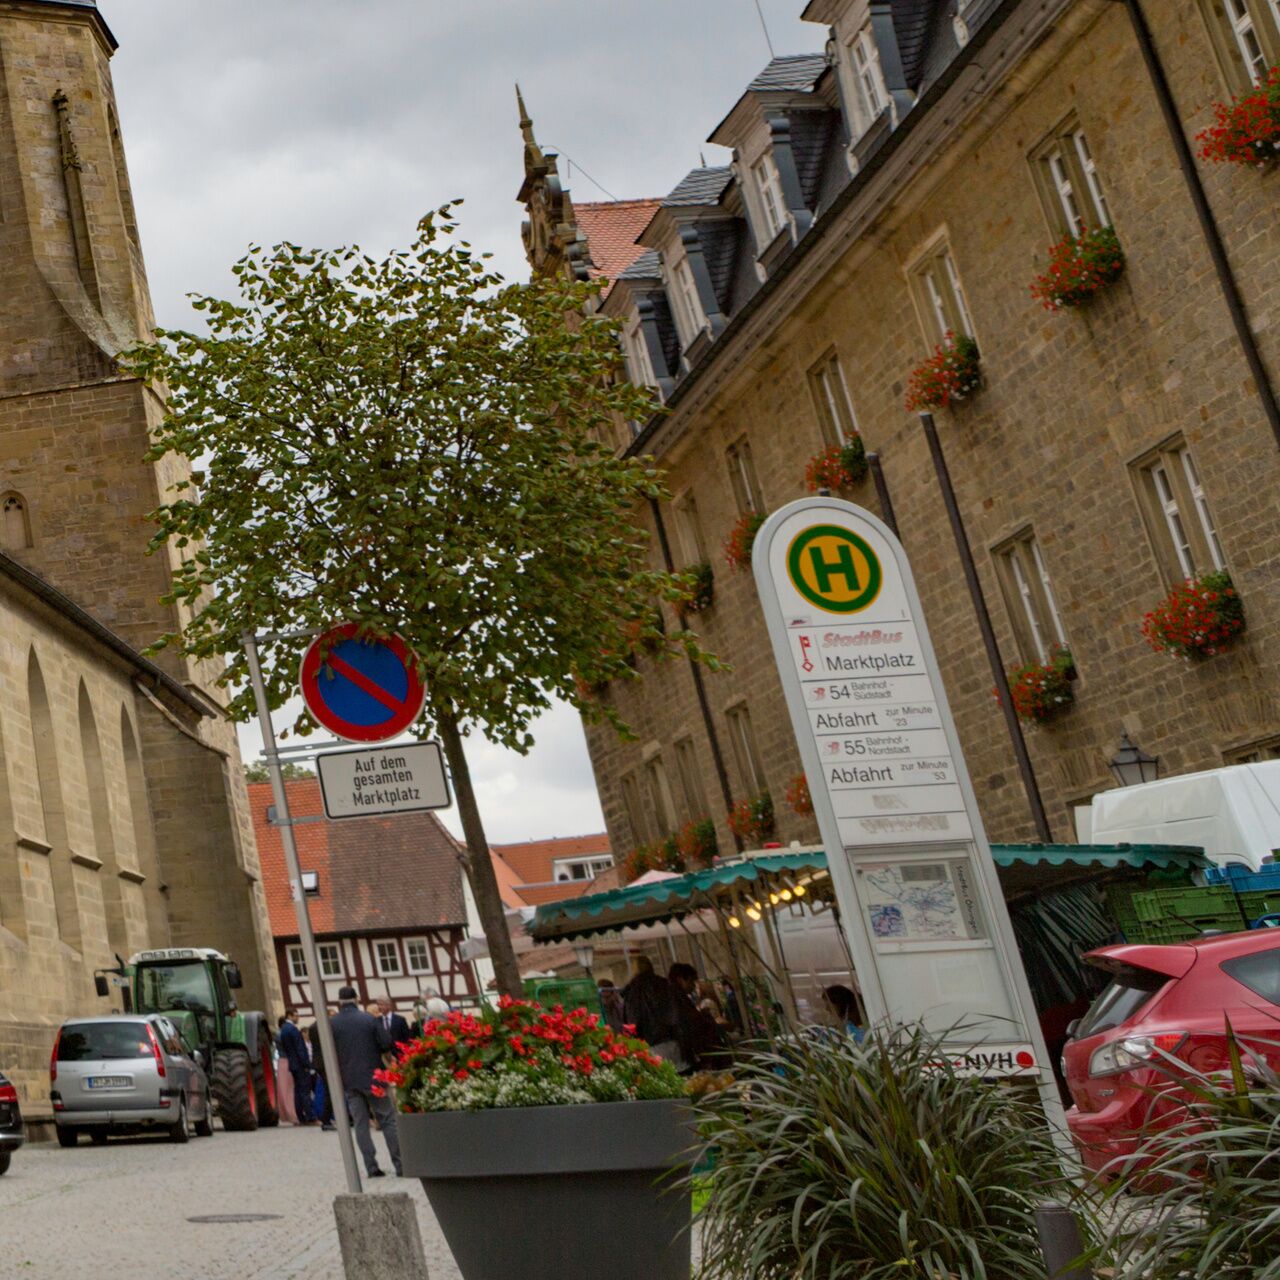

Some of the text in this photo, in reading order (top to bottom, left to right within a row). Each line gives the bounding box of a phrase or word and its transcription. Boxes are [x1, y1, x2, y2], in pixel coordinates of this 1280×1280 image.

[808, 544, 861, 594] H
[822, 629, 904, 649] StadtBus
[826, 653, 916, 672] Marktplatz
[829, 684, 851, 700] 54
[851, 680, 888, 691] Bahnhof
[885, 705, 933, 717] zur Minute
[816, 712, 879, 729] Abfahrt
[844, 740, 866, 756] 55
[865, 736, 903, 747] Bahnhof
[867, 746, 911, 756] Nordstadt
[354, 755, 407, 773] Auf dem
[900, 760, 949, 772] zur Minute
[353, 770, 414, 791] gesamten
[830, 767, 894, 784] Abfahrt
[352, 786, 421, 807] Marktplatz
[964, 1051, 1015, 1071] NVH
